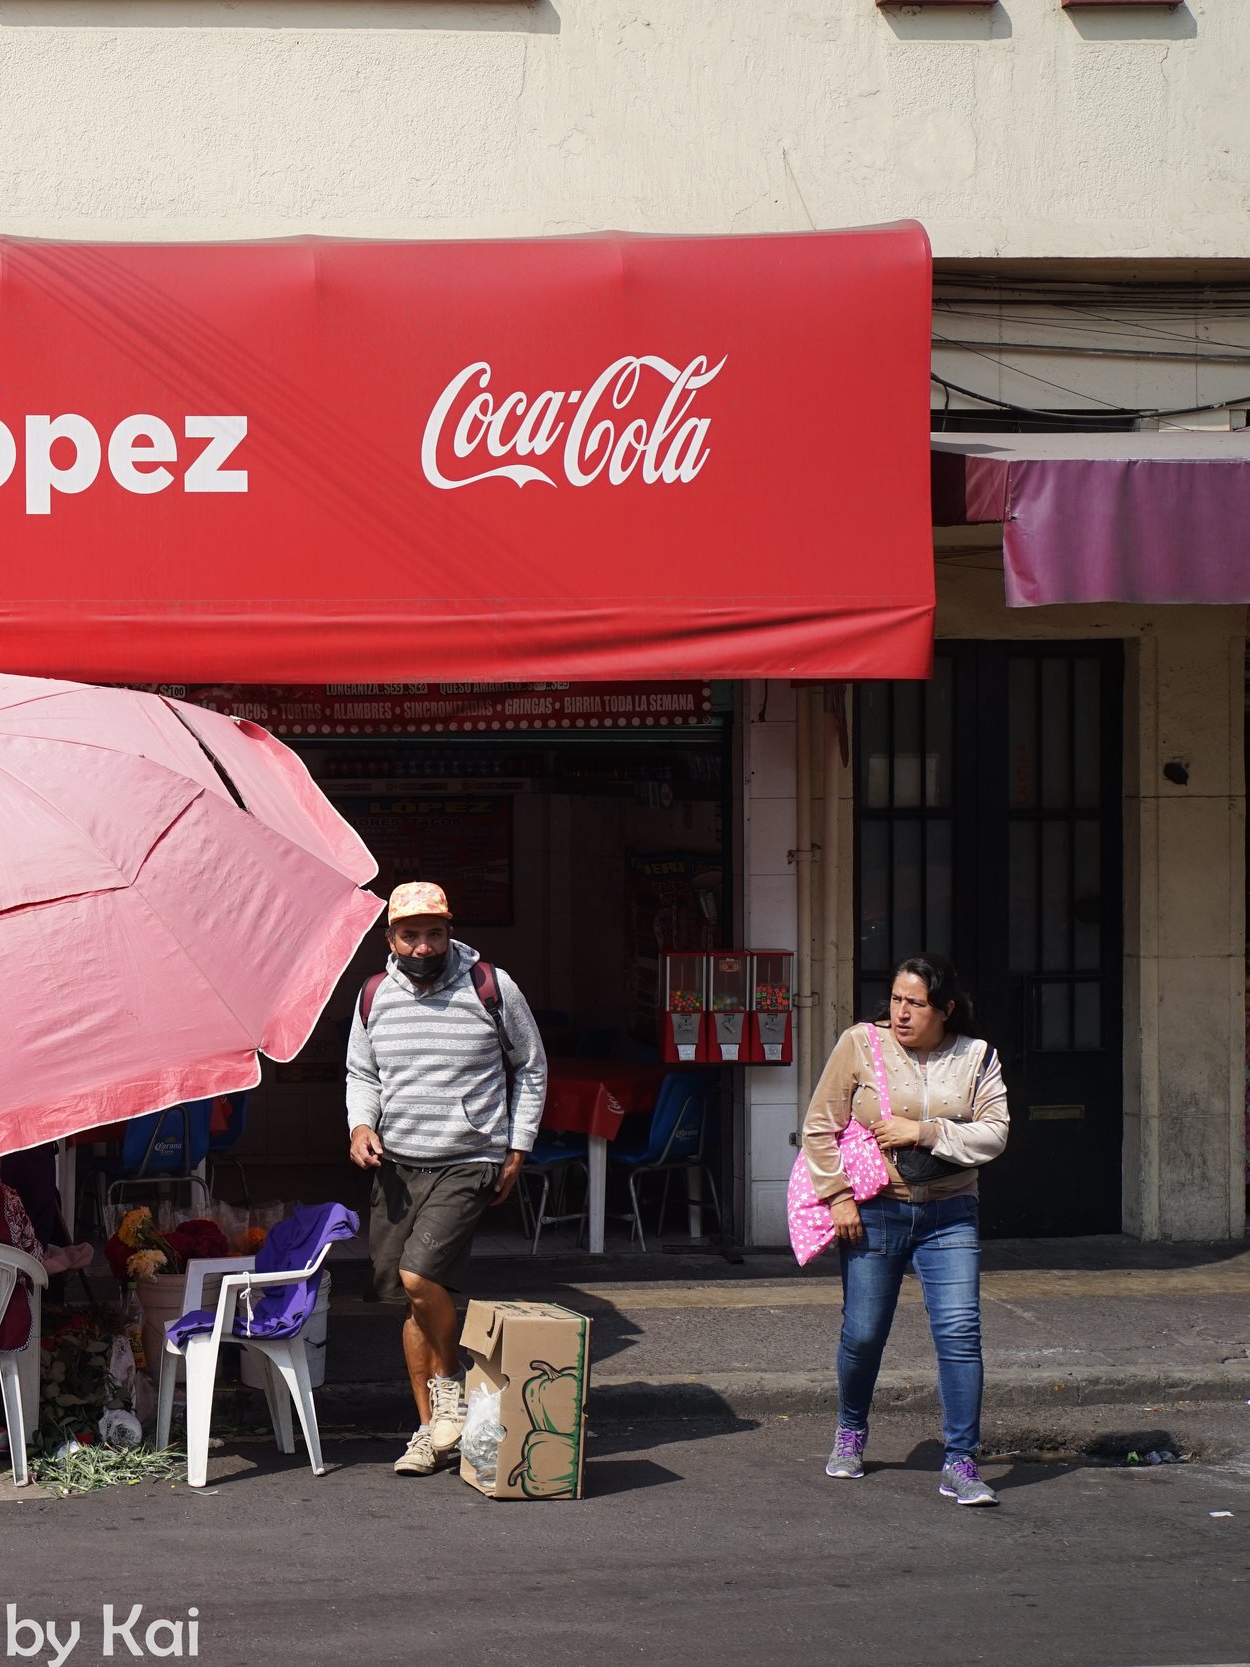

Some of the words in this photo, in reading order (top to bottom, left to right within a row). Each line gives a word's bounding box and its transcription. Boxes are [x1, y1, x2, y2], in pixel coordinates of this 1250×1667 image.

[421, 353, 729, 490] Coca-Cola
[232, 703, 269, 720] TACOS
[279, 703, 322, 720] TORTAS
[333, 702, 392, 719] ALAMBRES
[403, 700, 493, 718] SINCRONIZADAS
[505, 698, 553, 715] GRINGAS
[564, 696, 601, 713] BIRRIA
[603, 695, 633, 712] TODA
[635, 694, 647, 711] LA
[649, 693, 695, 711] SEMANA
[154, 1142, 183, 1152] Corona
